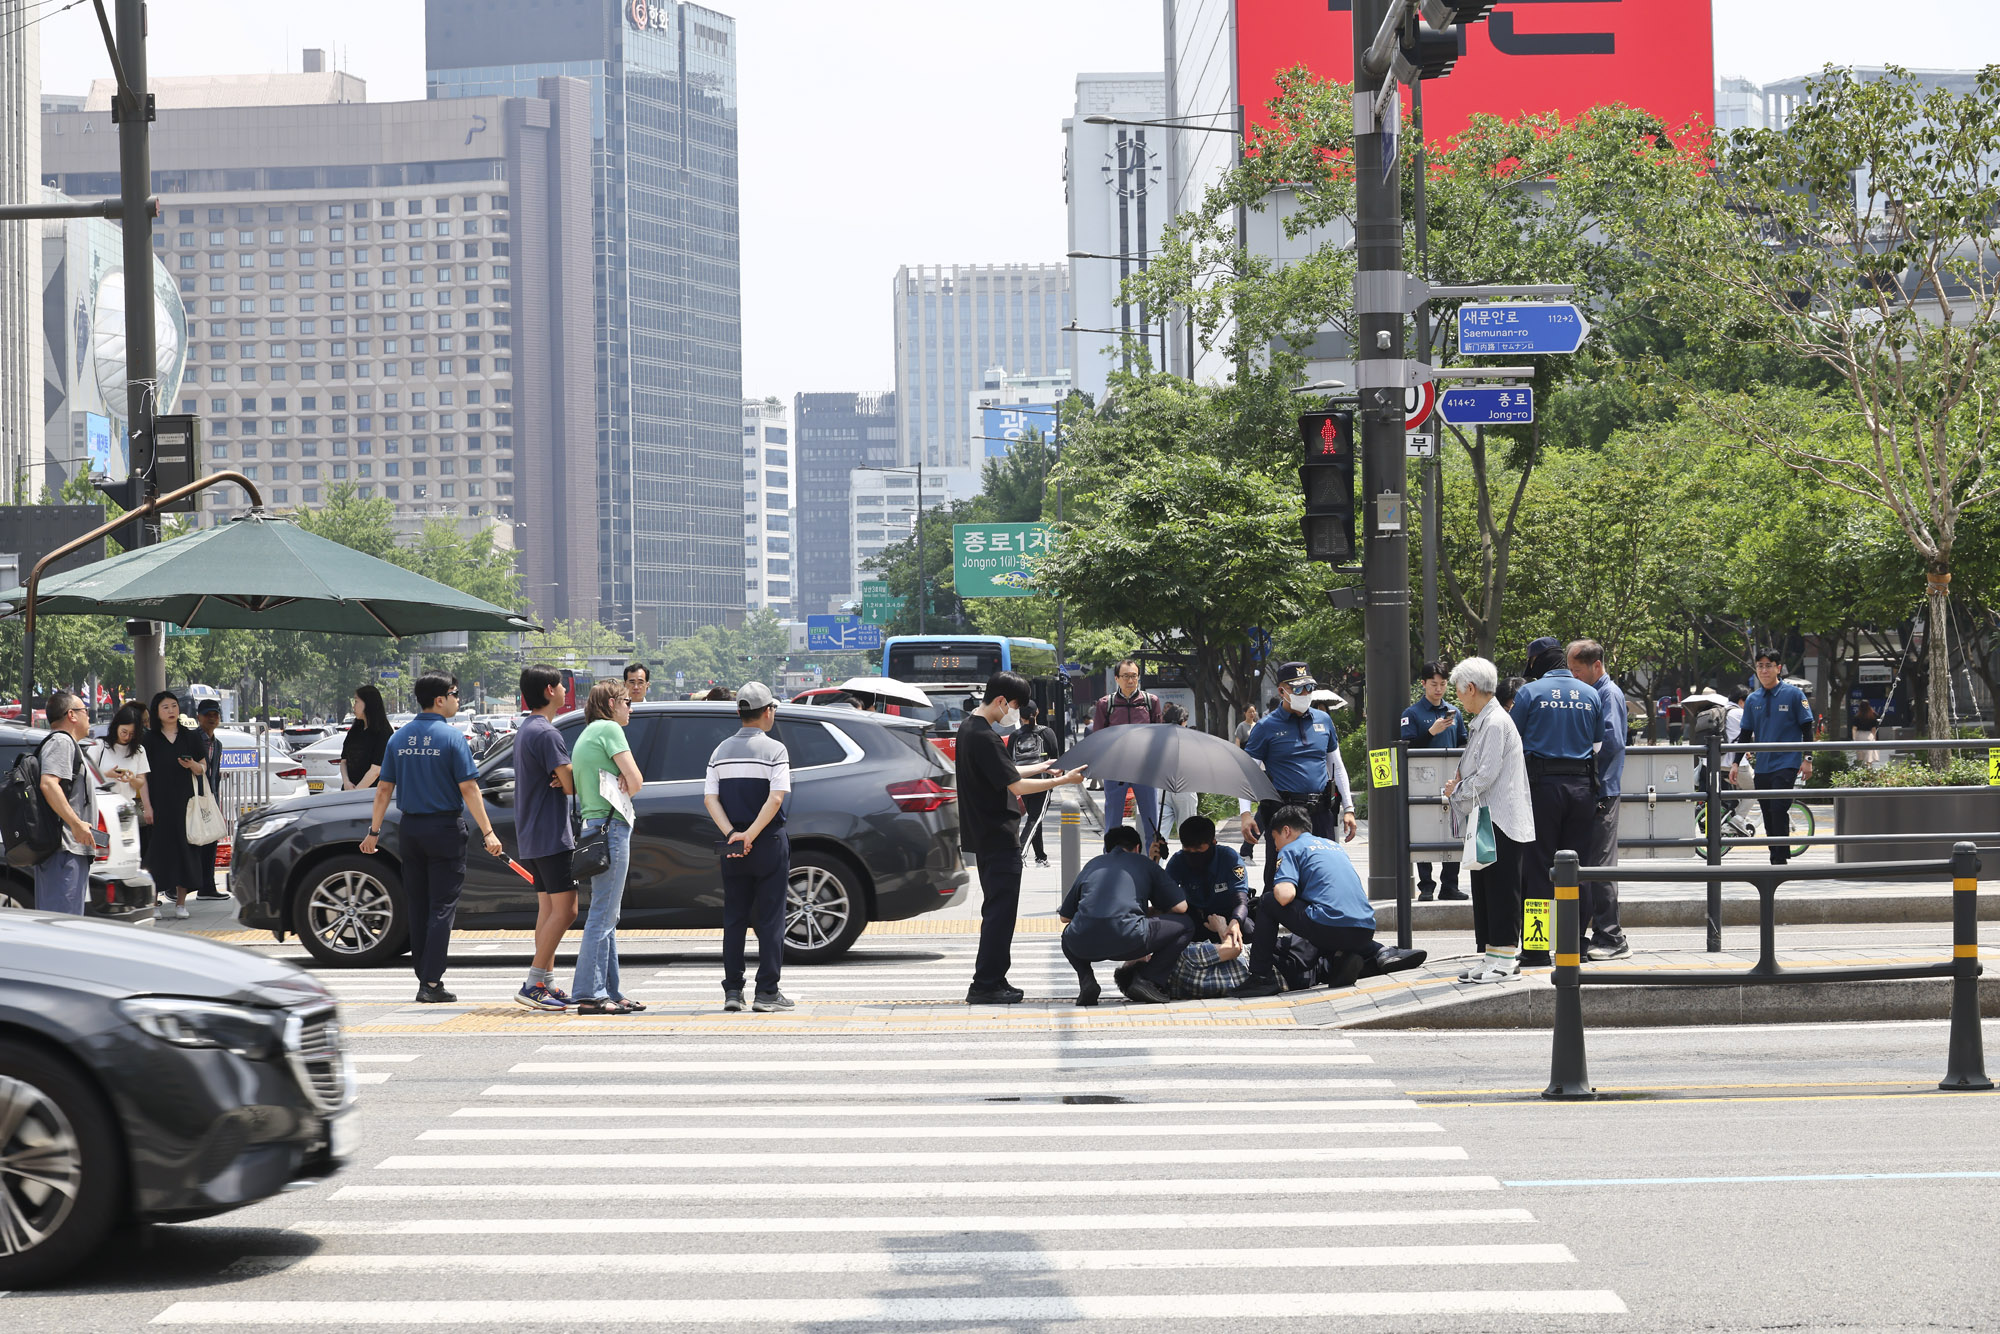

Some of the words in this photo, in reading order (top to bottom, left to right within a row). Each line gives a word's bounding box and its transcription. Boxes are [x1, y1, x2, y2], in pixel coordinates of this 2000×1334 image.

[648, 4, 669, 31] 한화
[1463, 310, 1520, 325] 새문안로
[1463, 328, 1529, 338] Saemunan-ro
[1464, 343, 1496, 351] 新门内路
[1501, 342, 1534, 350] セムナンロ
[1498, 392, 1528, 408] 종로
[1488, 411, 1529, 420] Jong-ro
[962, 531, 1051, 553] 종로1가
[962, 555, 997, 570] Jongno
[1000, 555, 1030, 570] 1(il)-g
[1551, 689, 1580, 700] 경찰
[1539, 700, 1592, 711] POLICE
[408, 735, 432, 746] 경찰
[398, 748, 441, 756] POLICE
[224, 754, 240, 765] POLICE
[240, 754, 251, 765] LINE
